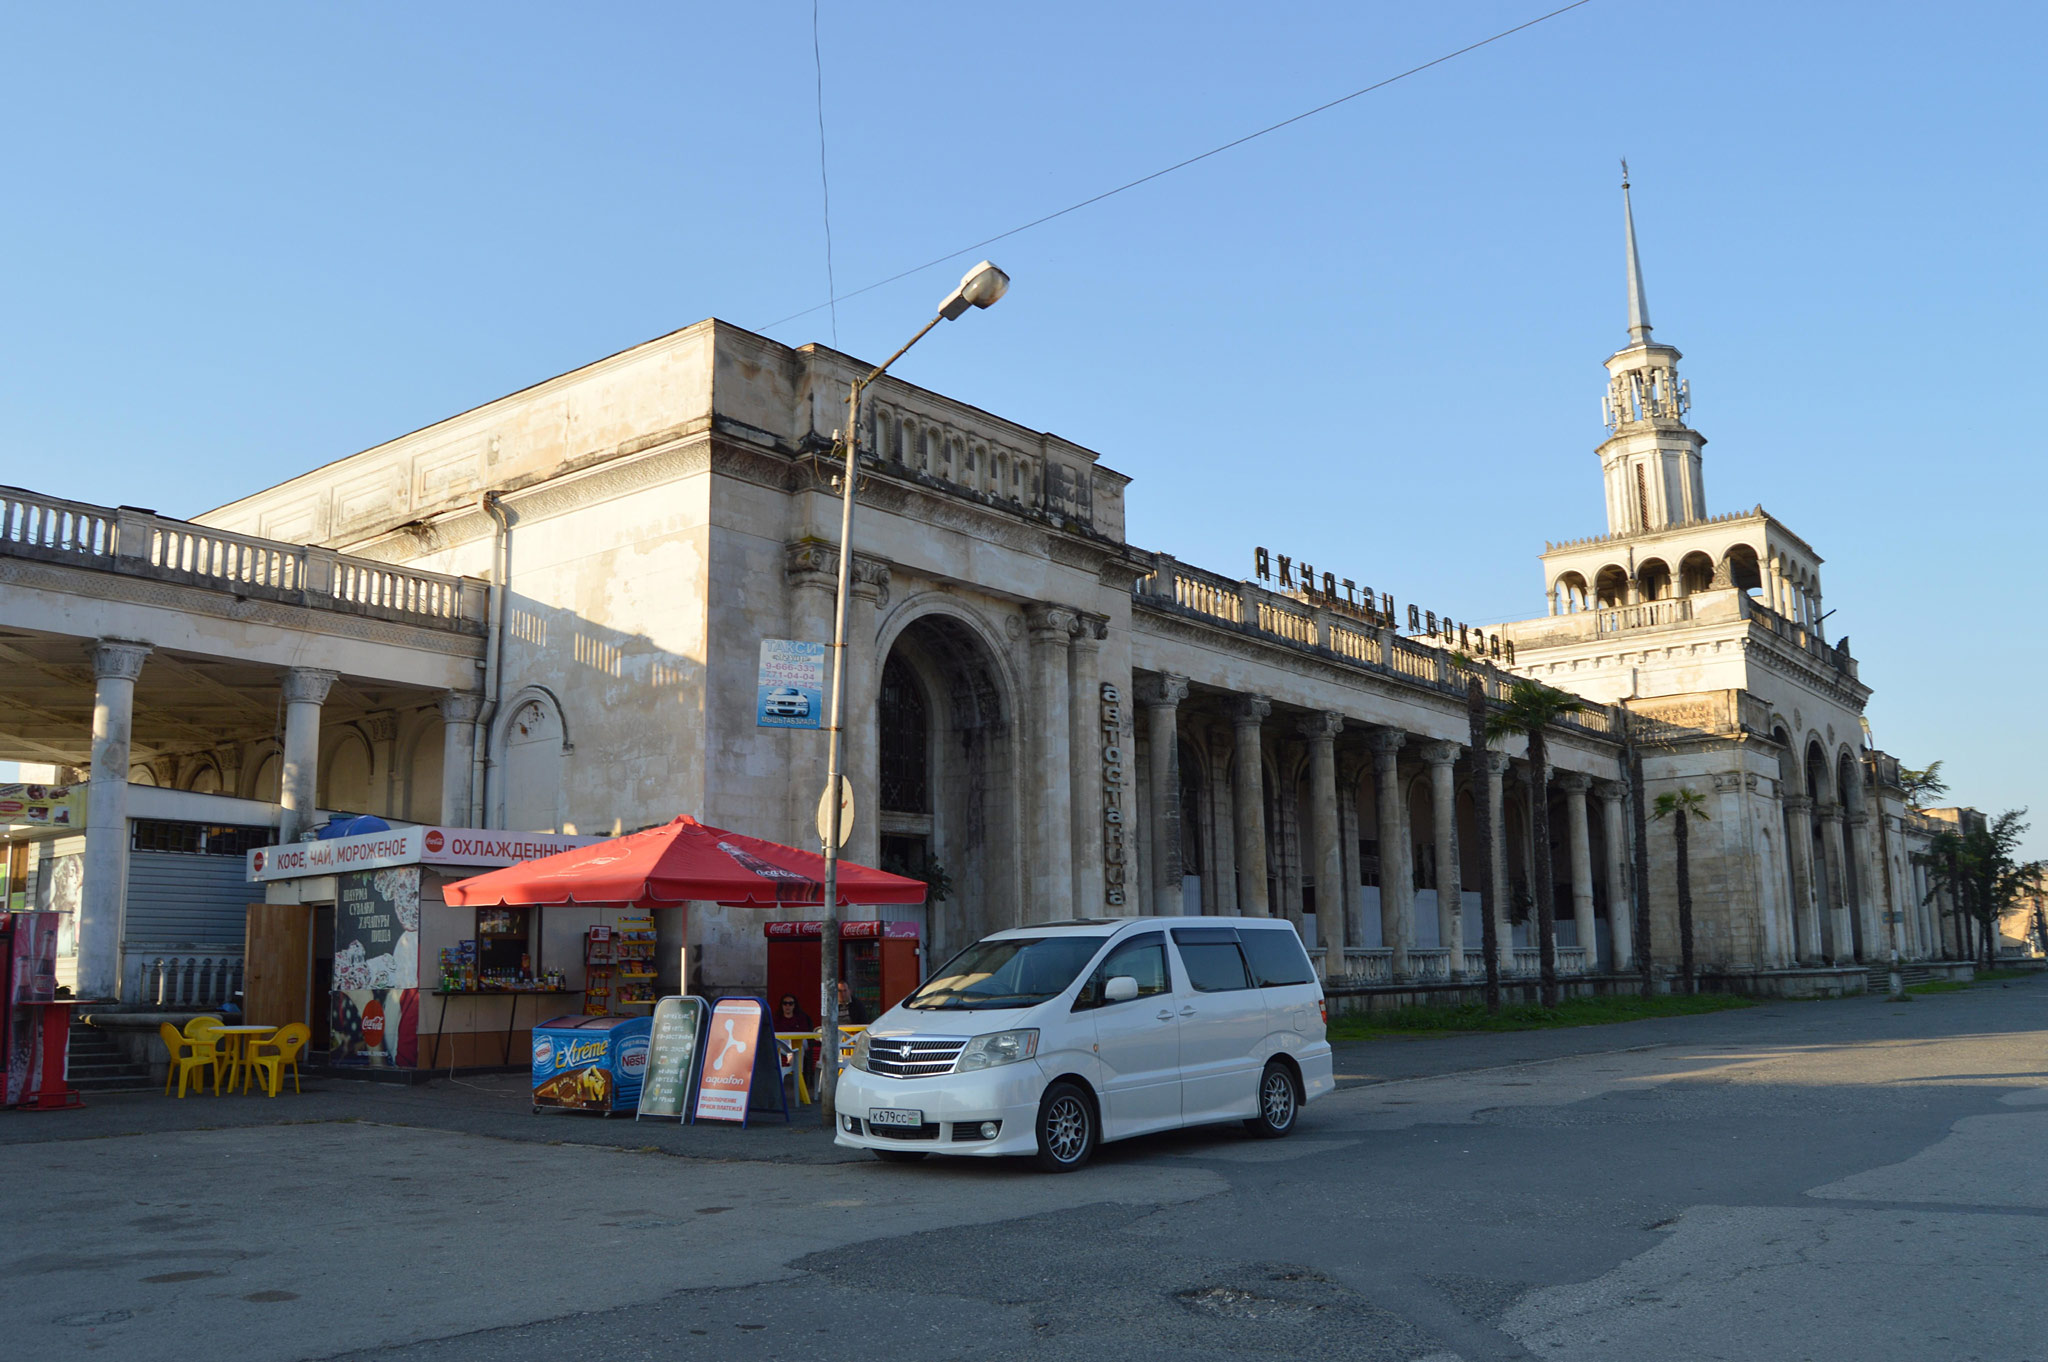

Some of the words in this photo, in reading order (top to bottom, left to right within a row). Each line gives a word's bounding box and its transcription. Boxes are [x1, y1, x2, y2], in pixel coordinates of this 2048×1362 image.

[765, 640, 818, 655] ТАКСИ
[765, 662, 816, 673] 9-666-333
[765, 671, 815, 681] 771-04-04
[277, 851, 307, 870] КОФЕ,
[310, 845, 334, 867] ЧАЙ,
[336, 838, 407, 864] МОРОЖЕНОЕ
[843, 923, 871, 936] Coca-Cola
[622, 1054, 647, 1067] Nestl
[705, 1074, 745, 1086] aquafon
